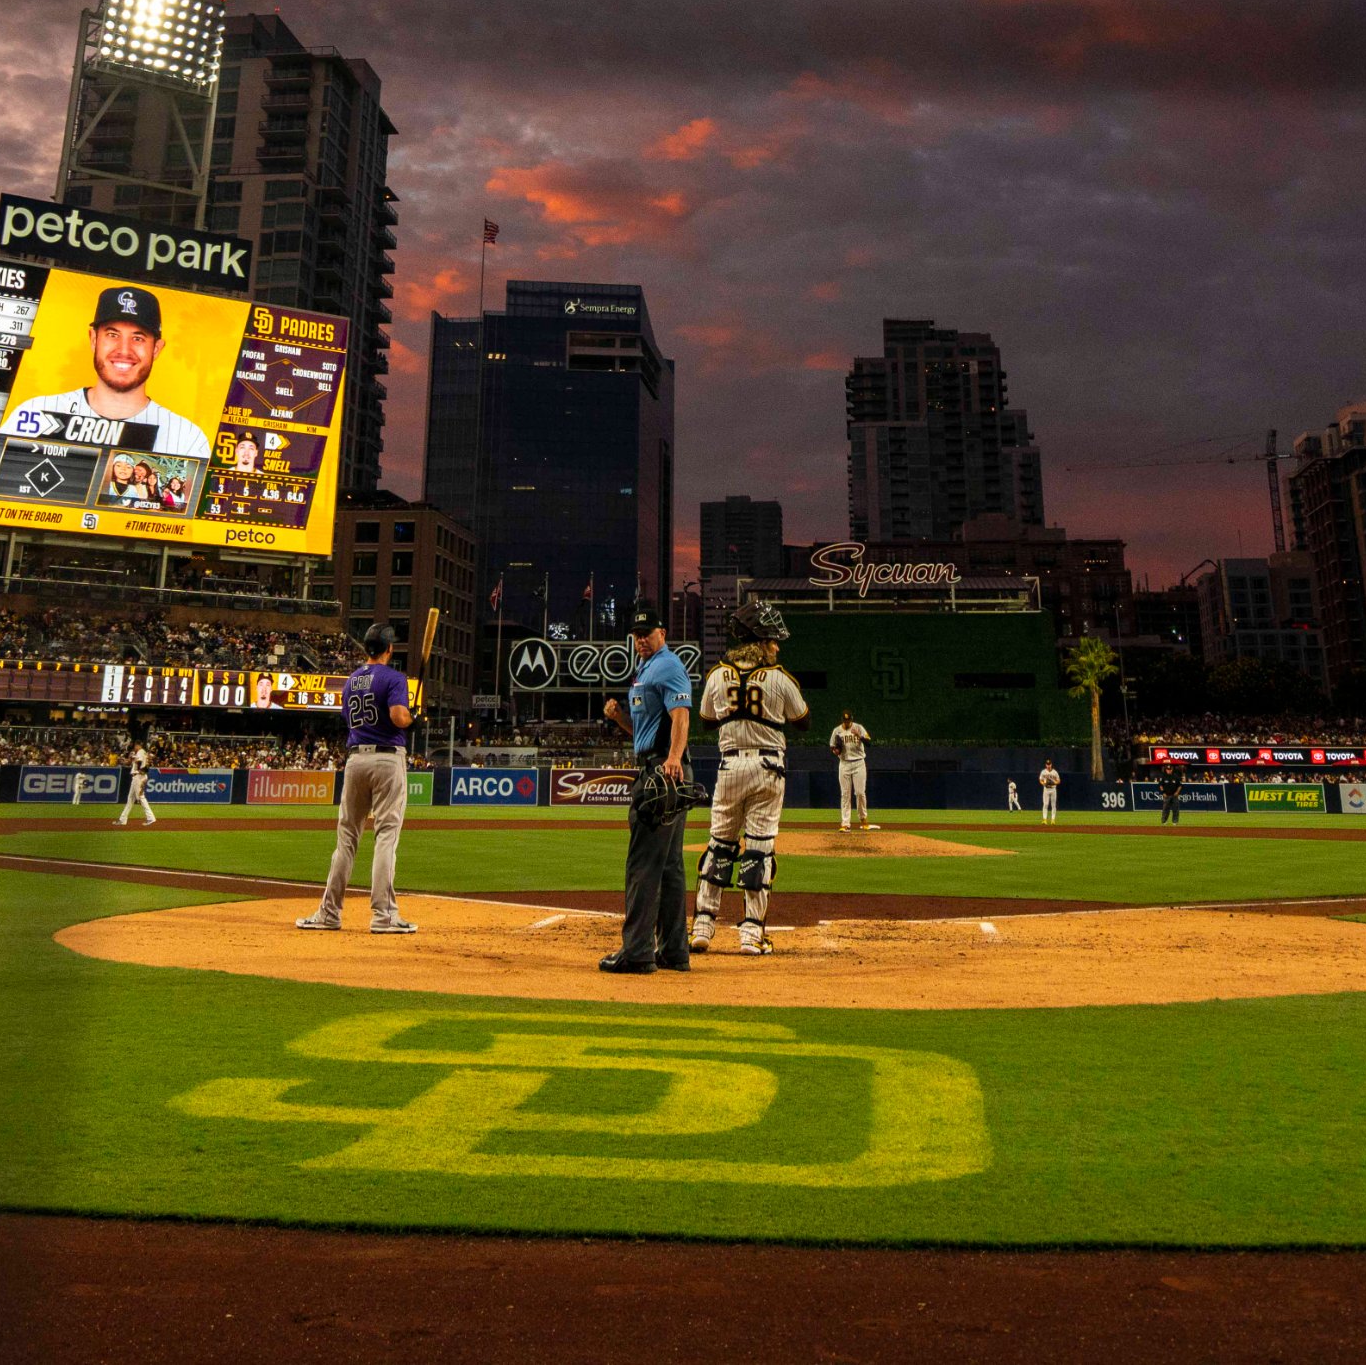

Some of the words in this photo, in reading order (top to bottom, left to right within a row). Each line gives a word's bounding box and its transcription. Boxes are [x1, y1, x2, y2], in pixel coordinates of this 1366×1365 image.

[1, 204, 140, 257] petco
[146, 233, 248, 278] park
[13, 305, 30, 315] .267
[580, 303, 609, 314] Sempra
[610, 305, 636, 315] Energy
[280, 316, 335, 342] PADRES
[16, 410, 41, 434] 25
[65, 414, 125, 446] CRON
[43, 445, 69, 458] TODAY
[263, 459, 291, 473] SNELL
[20, 510, 34, 521] THE
[34, 512, 63, 524] BOARD
[125, 520, 186, 536] #TIMETOSHINE
[225, 528, 276, 544] petco
[809, 542, 962, 598] Sycuan
[299, 677, 326, 691] SNELL
[297, 692, 308, 704] 16
[323, 693, 335, 705] 39
[348, 693, 379, 729] 25
[1169, 752, 1199, 760] TOYOTA
[1221, 752, 1251, 760] TOYOTA
[1273, 752, 1304, 760] TOYOTA
[146, 779, 217, 795] Southwest
[252, 777, 327, 799] illumina
[453, 777, 514, 796] ARCO
[557, 772, 631, 802] Sycuan
[1102, 791, 1125, 808] 396
[1140, 791, 1153, 802] UC
[1191, 792, 1218, 803] Health
[1248, 789, 1285, 802] WEST
[1287, 789, 1320, 802] LAKE
